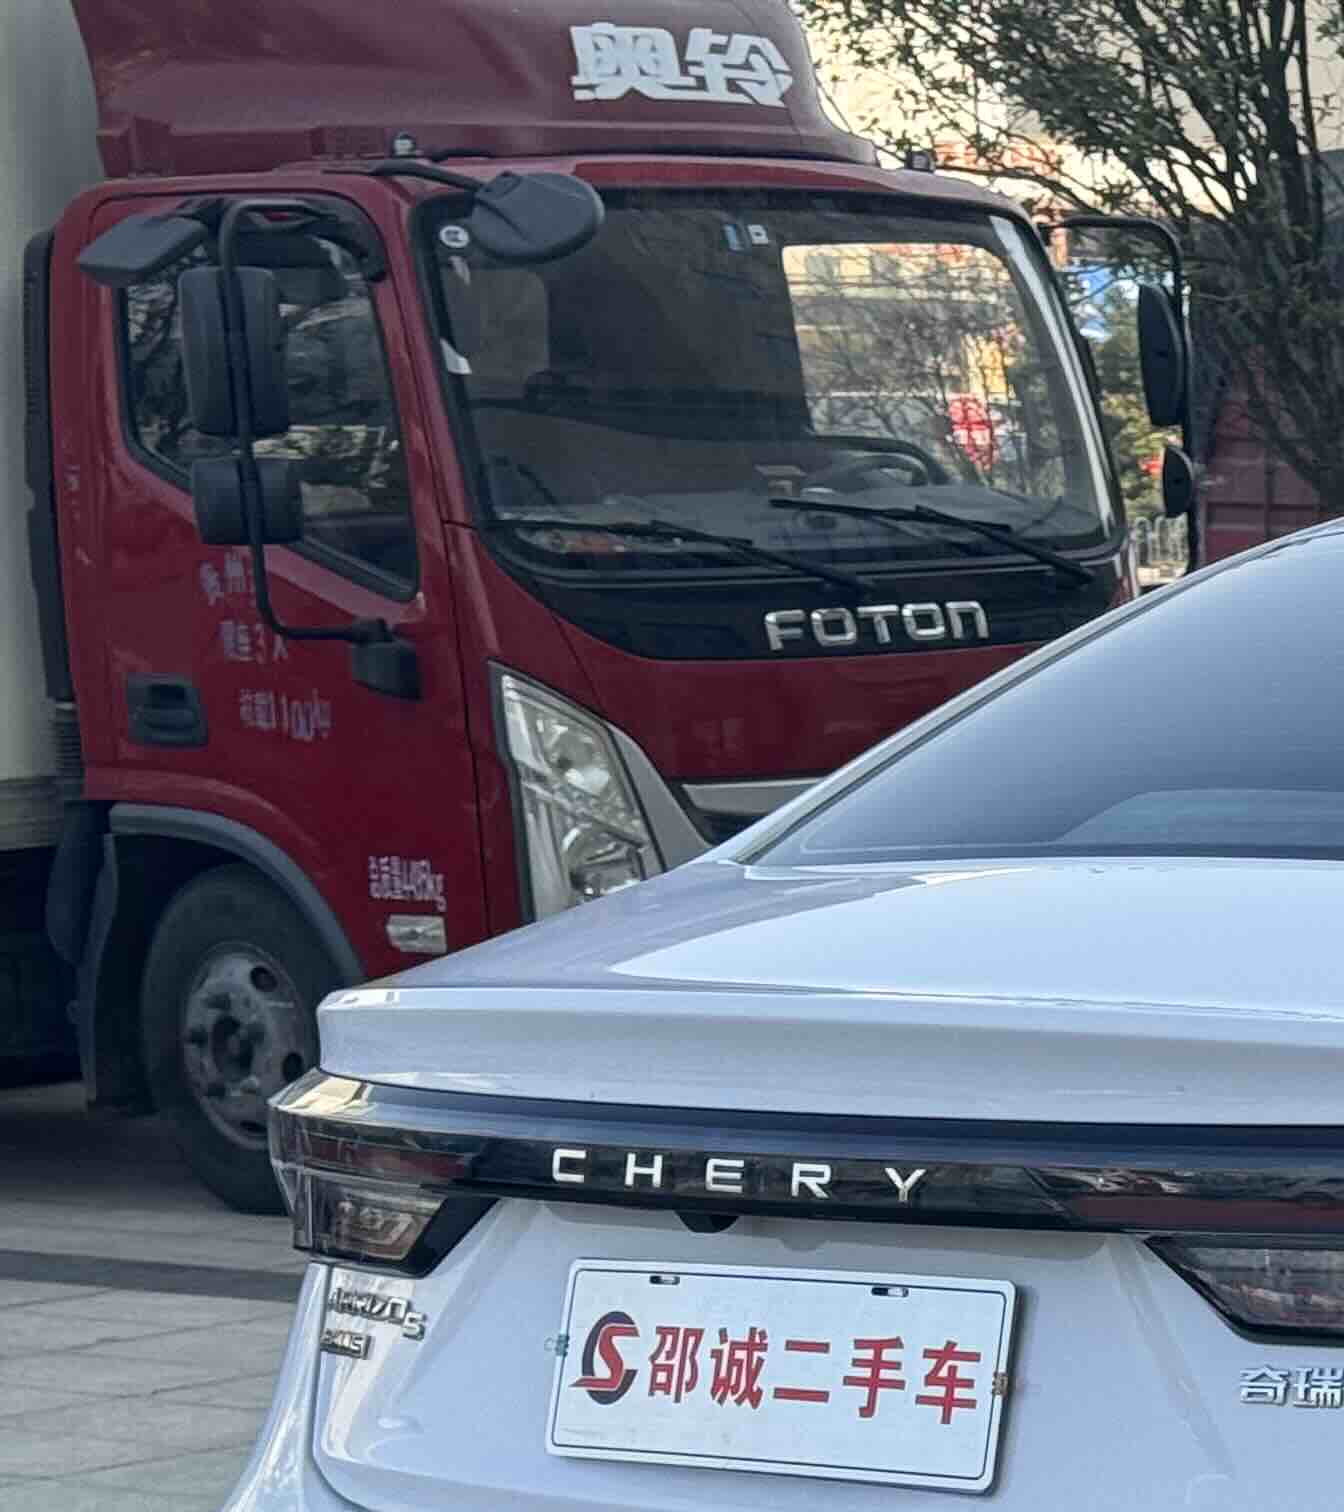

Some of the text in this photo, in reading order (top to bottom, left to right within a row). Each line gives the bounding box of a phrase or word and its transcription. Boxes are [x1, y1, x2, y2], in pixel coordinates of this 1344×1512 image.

[569, 21, 794, 108] 奥铃
[763, 600, 990, 651] FOTON
[551, 1147, 925, 1202] CHERY
[647, 1324, 983, 1425] 邵诚二手车
